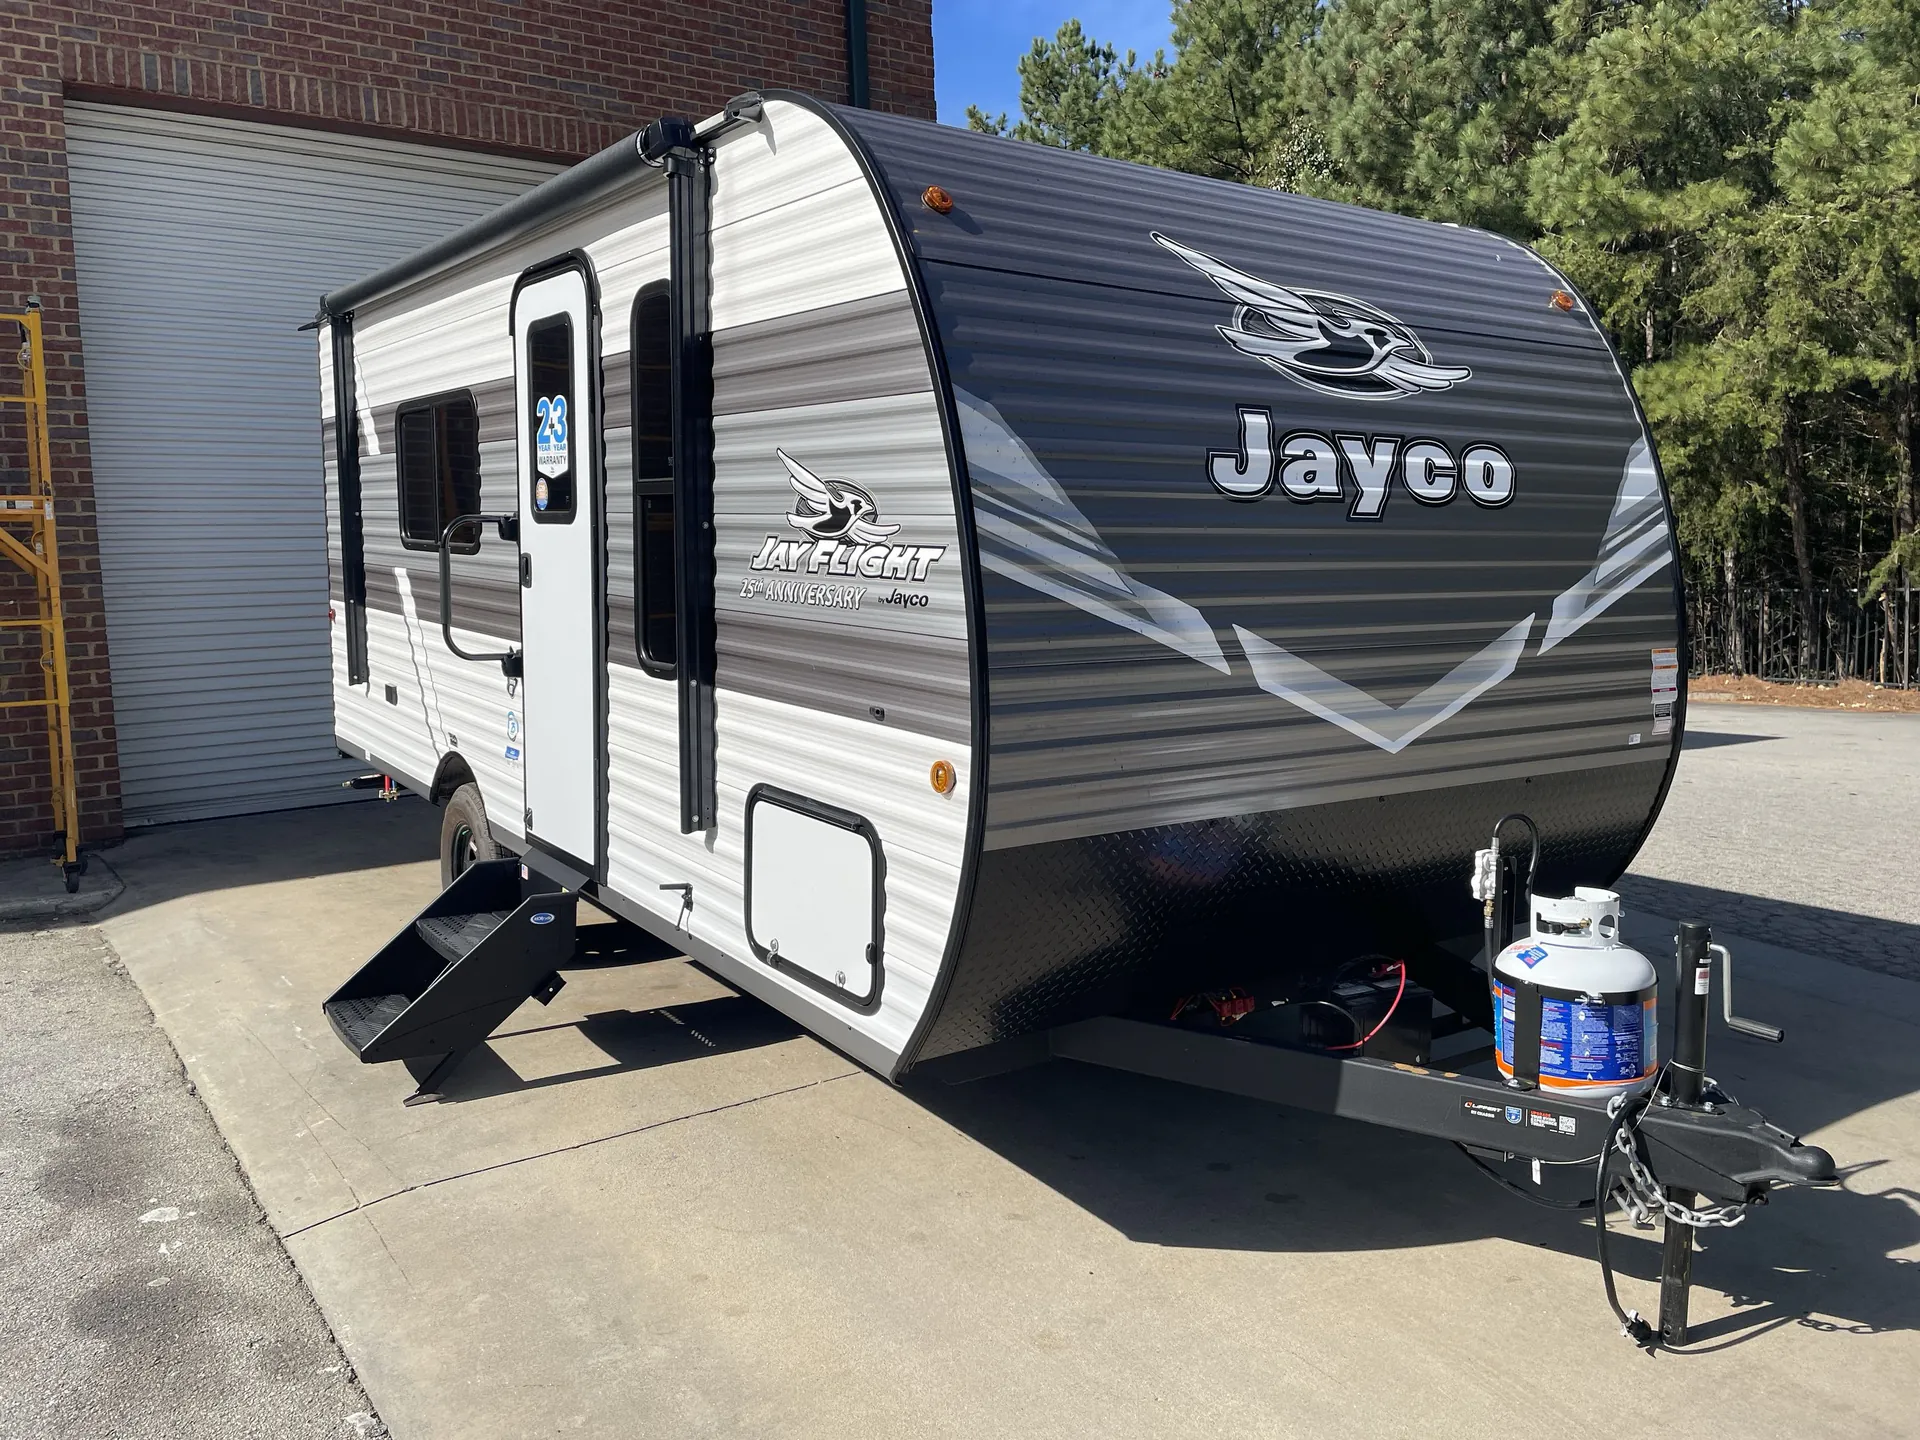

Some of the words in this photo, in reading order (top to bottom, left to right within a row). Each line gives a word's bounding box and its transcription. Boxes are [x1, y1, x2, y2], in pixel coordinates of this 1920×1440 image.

[539, 443, 551, 452] YEAR
[553, 443, 567, 452] YEAR
[539, 455, 567, 465] WARRANTY
[1206, 403, 1517, 522] Jayco
[749, 535, 814, 573] JAY
[806, 538, 947, 582] FLIGHT
[740, 578, 764, 599] 25th
[765, 579, 867, 610] ANNIVERSARY
[878, 595, 886, 604] by
[885, 588, 929, 609] Jayco
